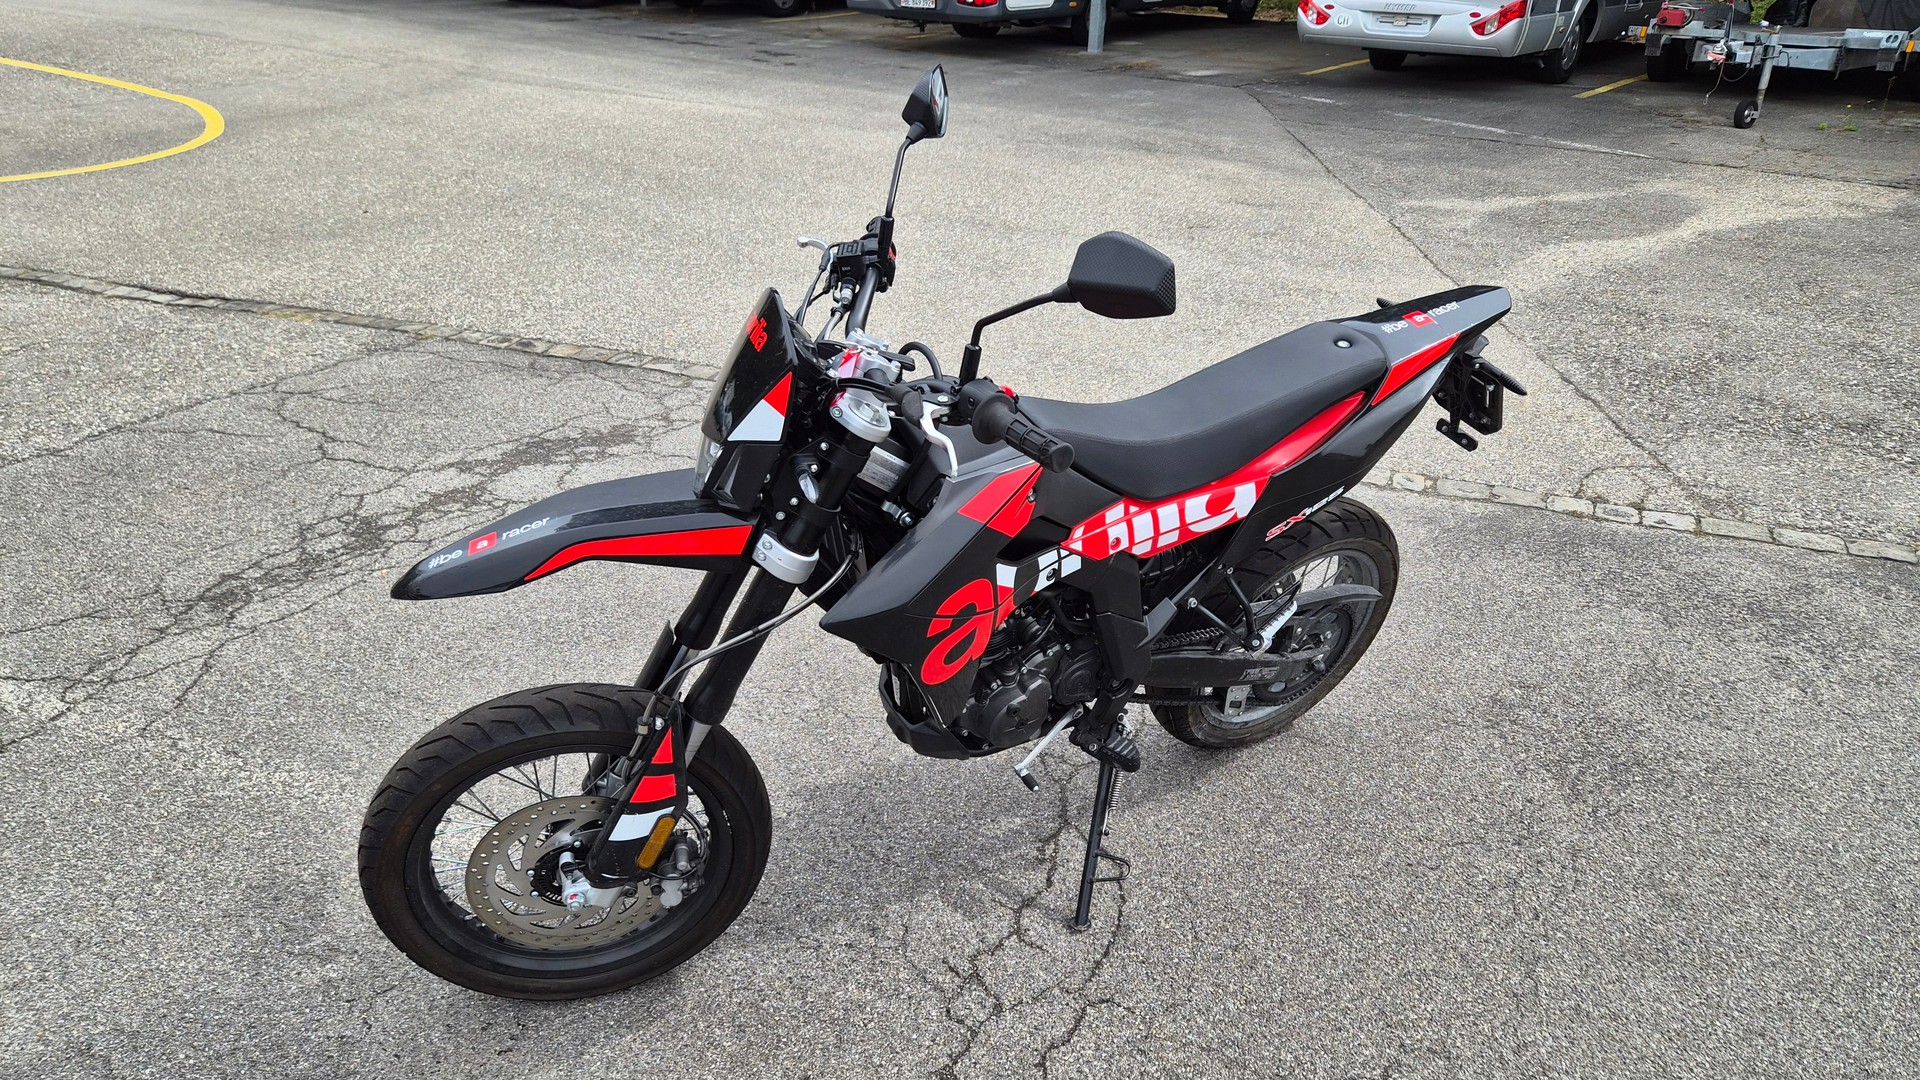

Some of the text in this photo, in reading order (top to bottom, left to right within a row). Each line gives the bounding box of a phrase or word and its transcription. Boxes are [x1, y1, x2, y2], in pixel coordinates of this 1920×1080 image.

[1337, 15, 1349, 25] CH
[1381, 319, 1409, 334] #be
[1427, 301, 1460, 317] racer
[428, 549, 463, 569] #be
[502, 517, 550, 540] racer
